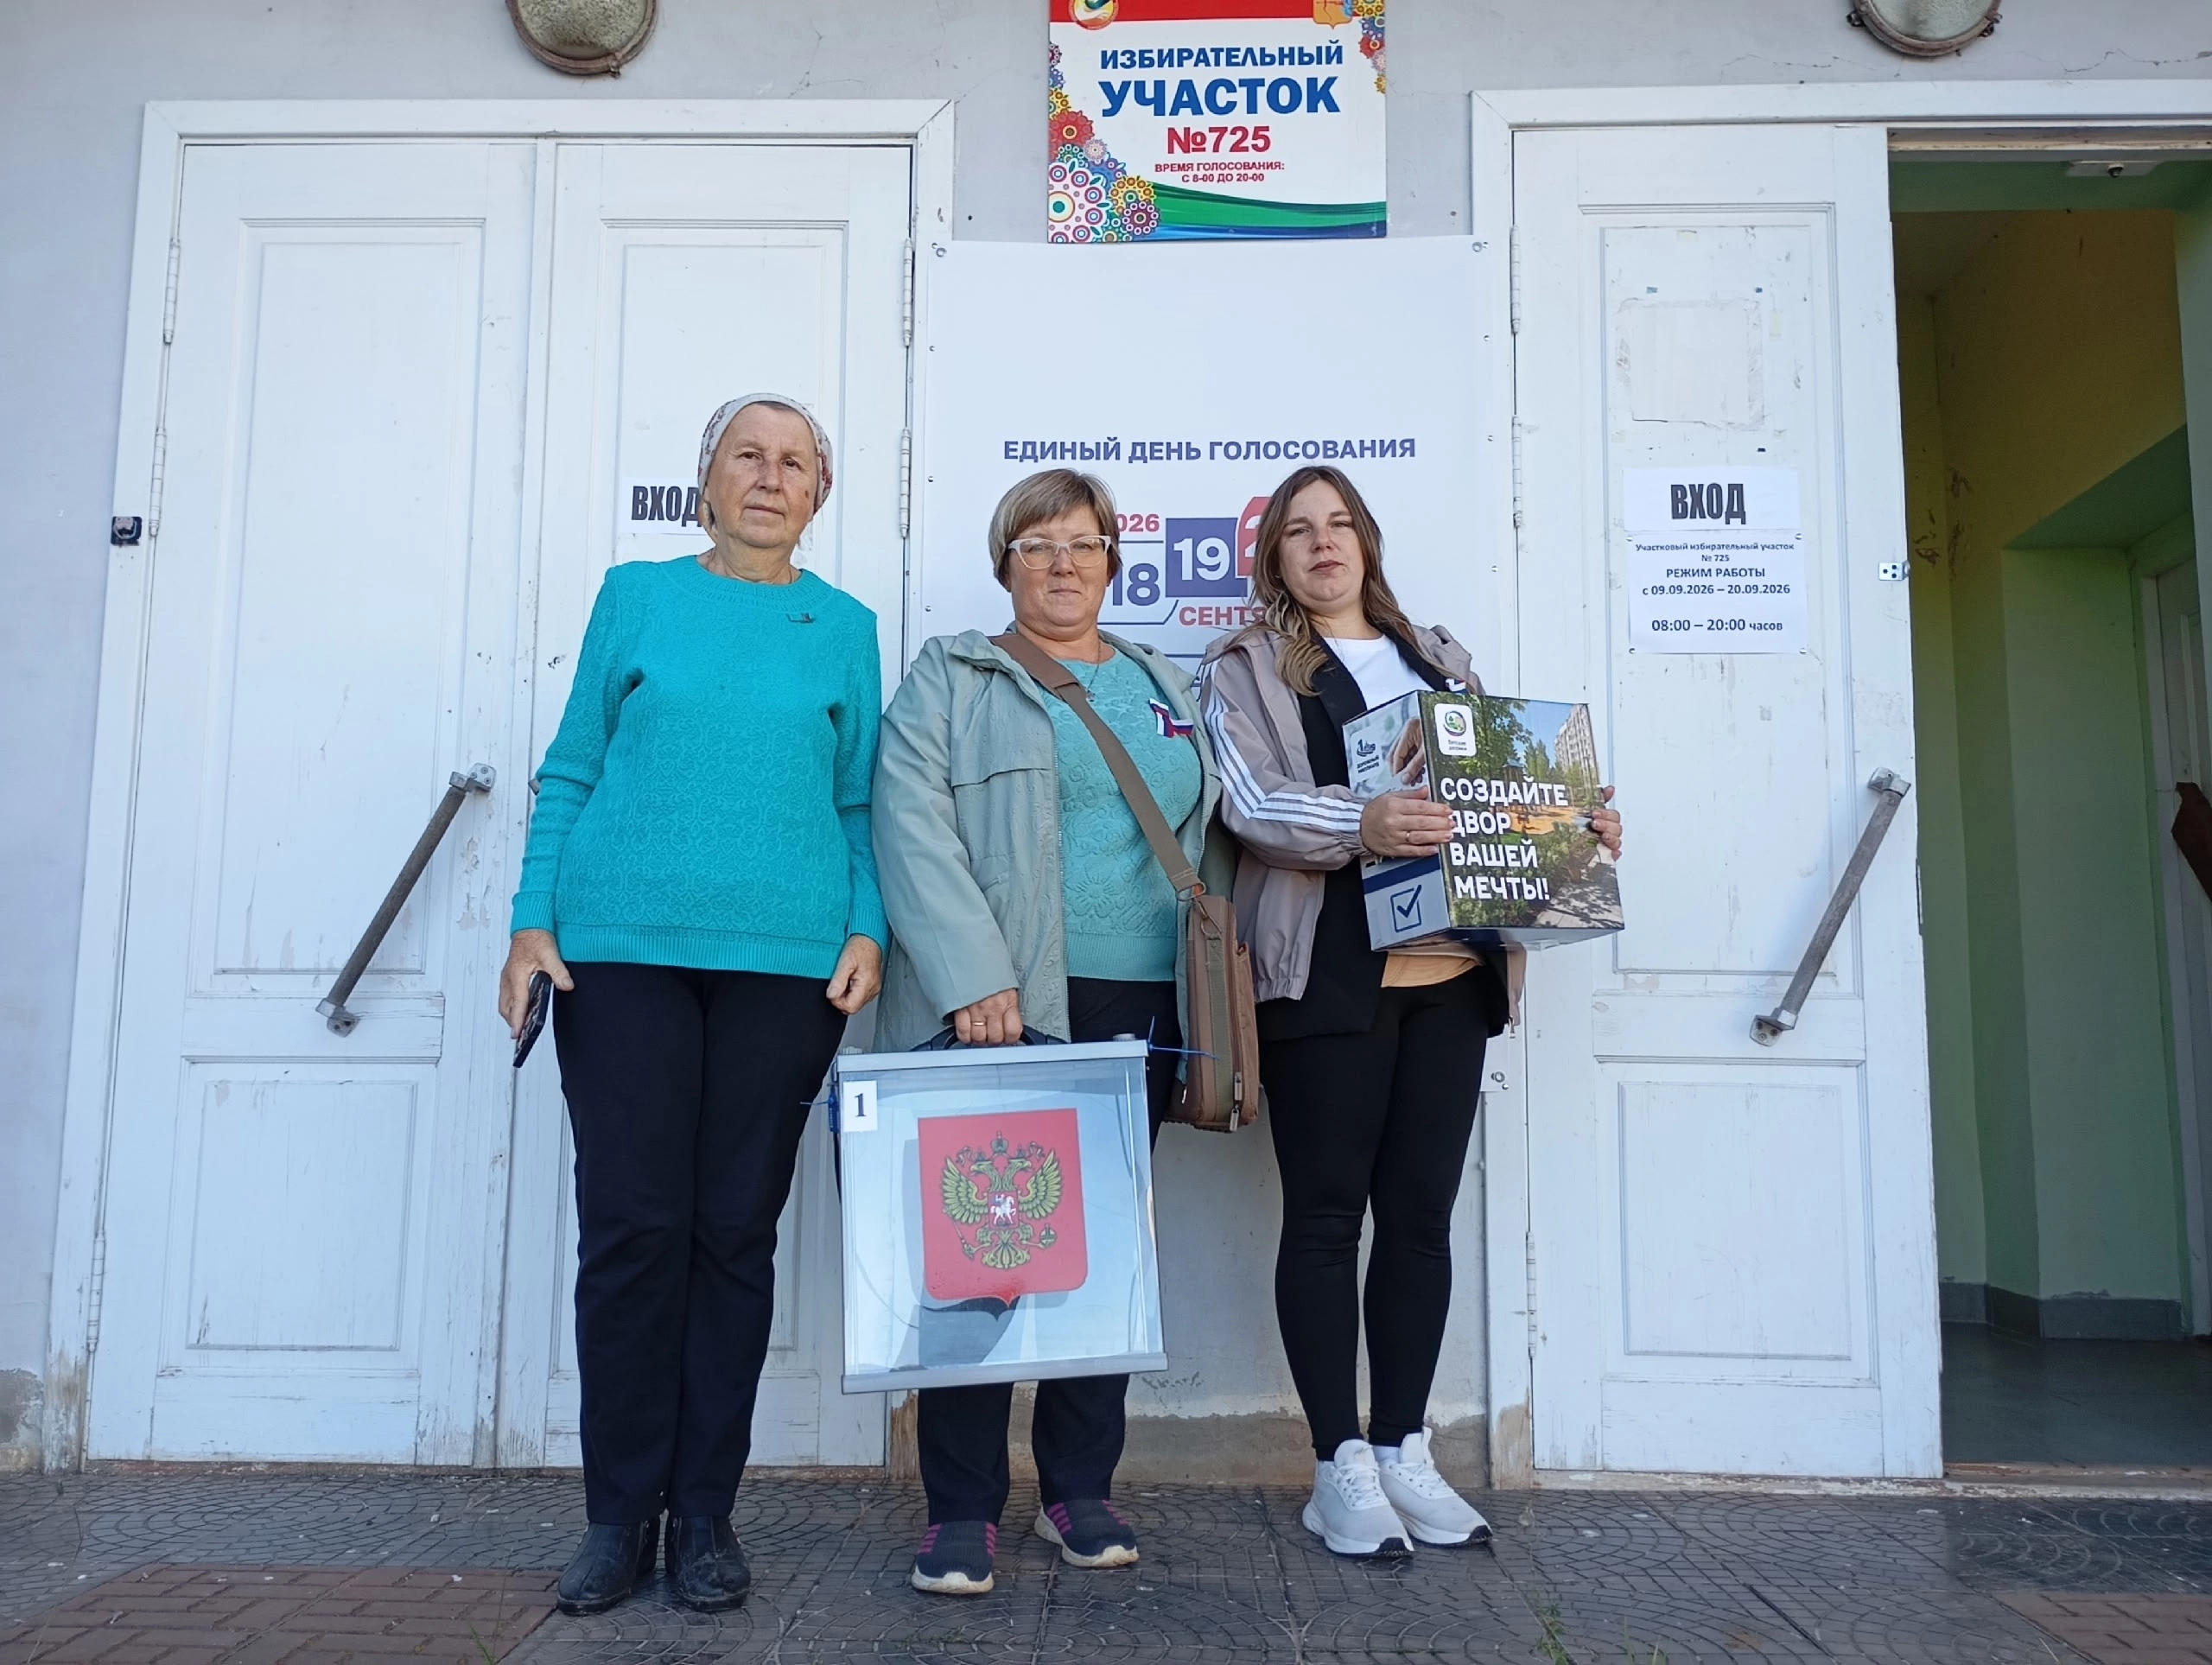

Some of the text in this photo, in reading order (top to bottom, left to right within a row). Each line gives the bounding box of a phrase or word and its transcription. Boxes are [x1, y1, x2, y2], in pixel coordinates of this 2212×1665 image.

[1100, 40, 1344, 69] ИЗБИРАТЕЛЬНЫЙ
[1099, 77, 1340, 117] УЧАСТОК
[1167, 126, 1271, 155] №725
[1155, 162, 1285, 173] ВРЕМЯ ГОЛОСОВАНИЯ:
[1217, 174, 1234, 184] ДО
[1236, 173, 1265, 182] 20-00
[1004, 436, 1415, 463] ЕДИНЫЙ ДЕНЬ ГОЛОСОВАНИЯ
[632, 486, 703, 527] ВХОД
[1671, 483, 1746, 524] ВХОД
[1116, 513, 1160, 532] 026
[1173, 537, 1230, 581] 19
[1636, 543, 1795, 551] Участковый избирательный участок
[1666, 568, 1765, 578] РЕЖИМ РАБОТЫ
[1651, 585, 1714, 594] 09.09.2026
[1727, 584, 1790, 594] 20.09.2026
[1179, 607, 1267, 626] СЕНТЯ
[1651, 620, 1691, 632] 08:00
[1707, 619, 1746, 632] 20:00
[1749, 622, 1783, 632] часов
[1440, 776, 1568, 806] СОЗДАЙТЕ
[1449, 838, 1538, 868] ВАШЕЙ
[1453, 875, 1551, 901] МЕЧТЫ!
[855, 1092, 867, 1117] 1
